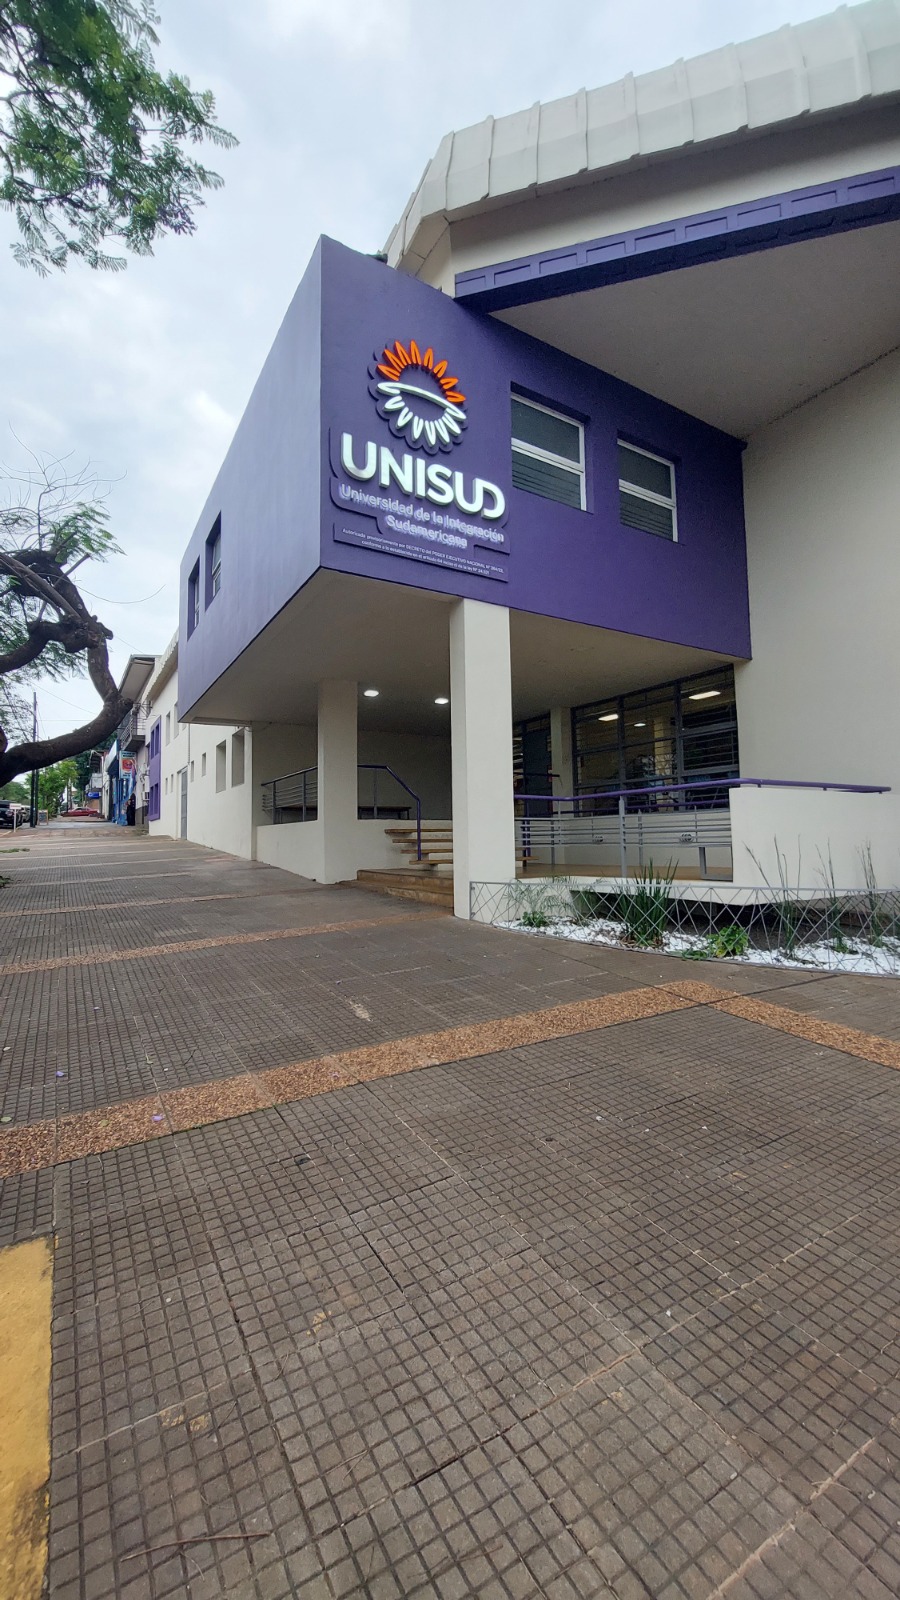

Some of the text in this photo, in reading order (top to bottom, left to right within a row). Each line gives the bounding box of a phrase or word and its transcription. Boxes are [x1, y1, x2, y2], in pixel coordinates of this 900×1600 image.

[341, 432, 506, 519] UNISUD
[340, 482, 504, 542] Universidad de la Integración
[386, 514, 467, 548] Sudamericana
